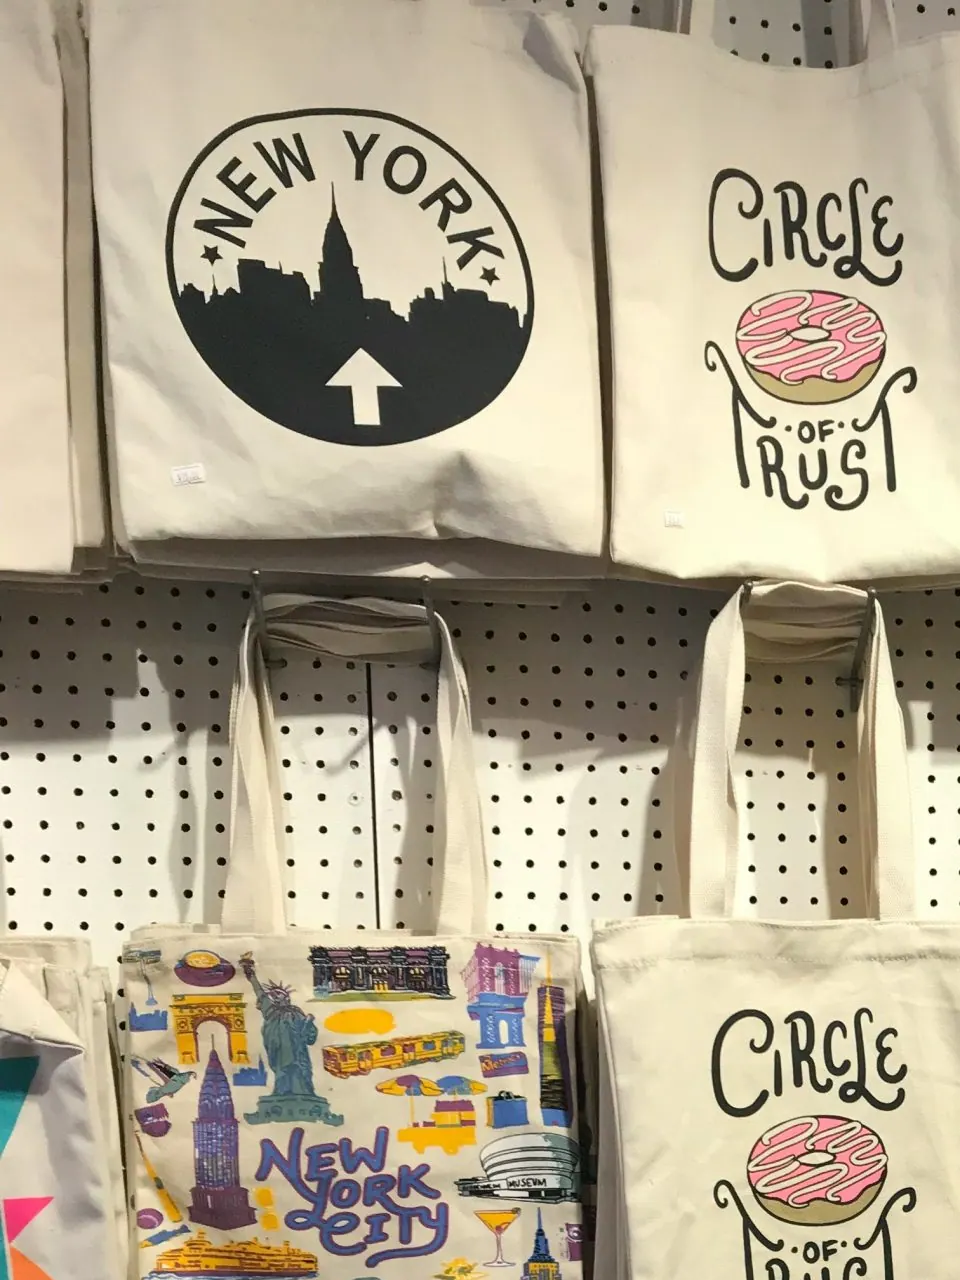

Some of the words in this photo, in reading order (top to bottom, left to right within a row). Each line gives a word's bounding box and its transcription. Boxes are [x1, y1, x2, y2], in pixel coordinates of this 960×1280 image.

[193, 132, 316, 249] NEW
[342, 130, 505, 271] YORK
[797, 419, 834, 444] OF
[255, 1126, 389, 1202] NEW
[284, 1163, 441, 1230] YORK
[802, 1239, 839, 1264] OF
